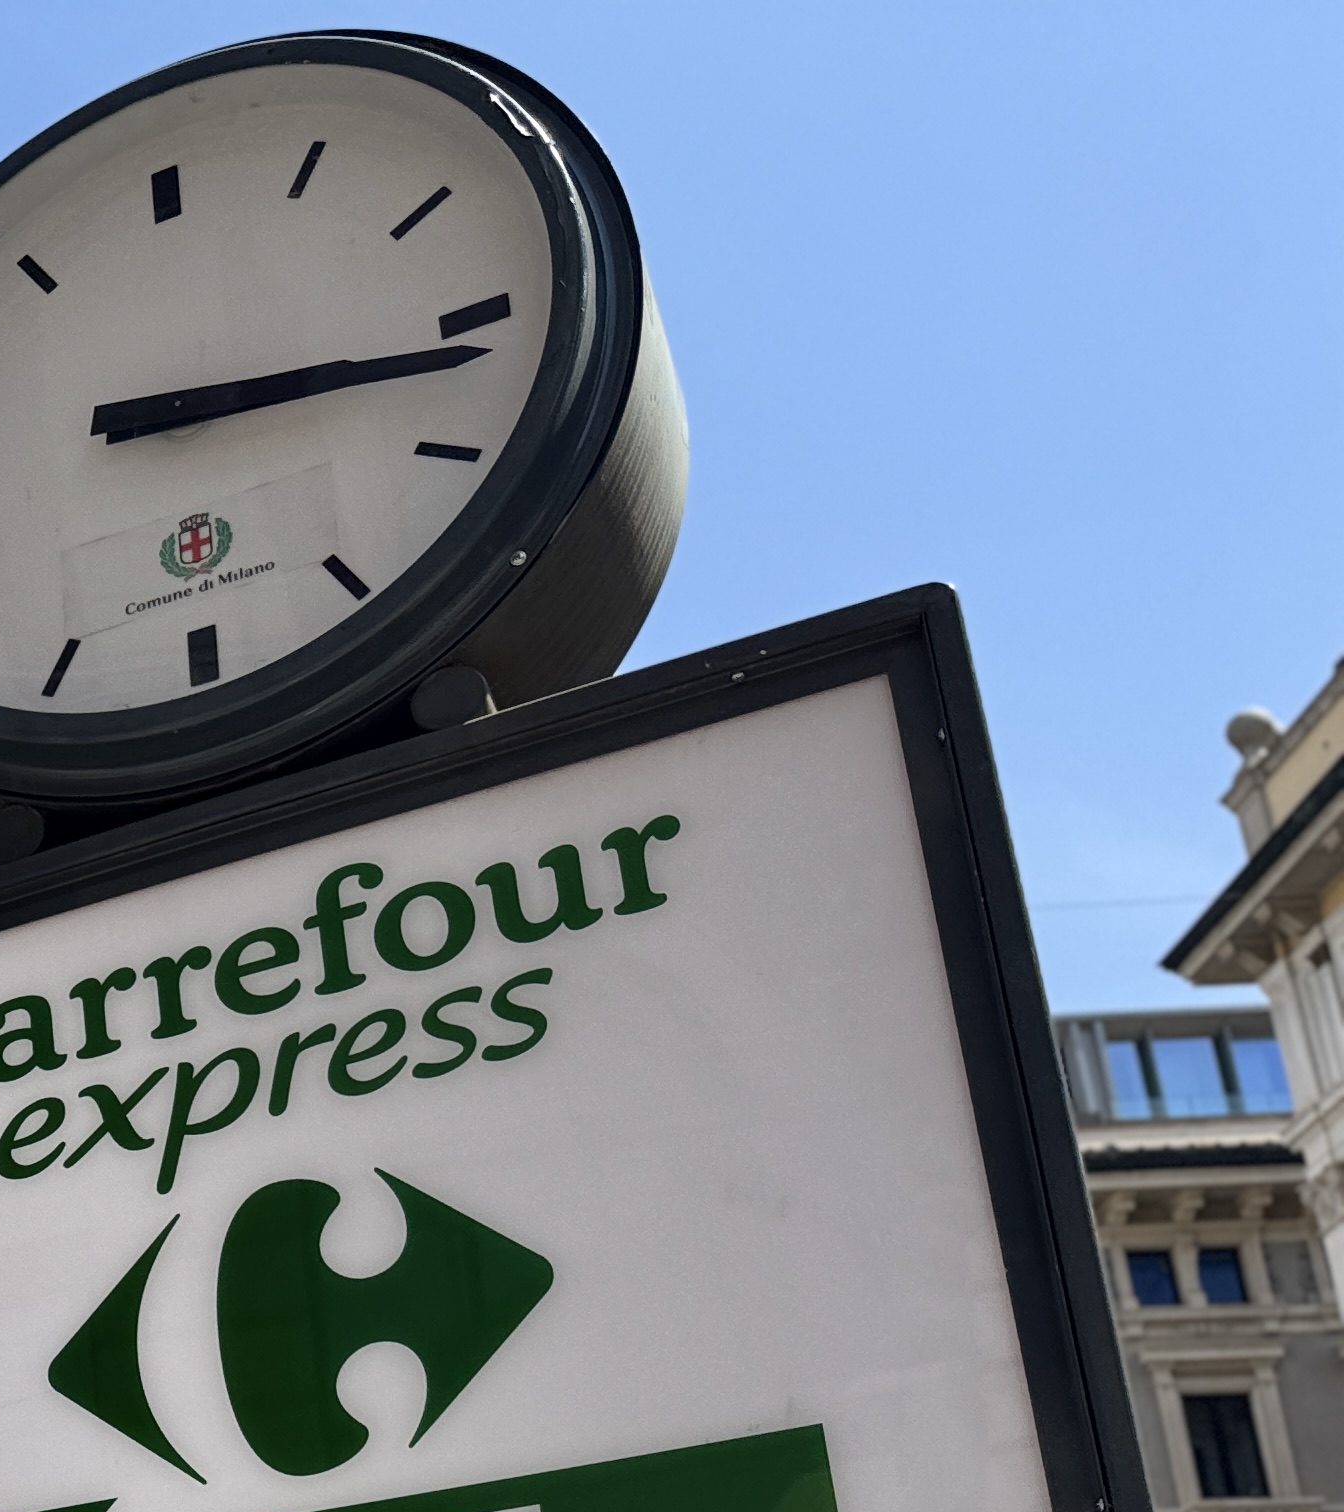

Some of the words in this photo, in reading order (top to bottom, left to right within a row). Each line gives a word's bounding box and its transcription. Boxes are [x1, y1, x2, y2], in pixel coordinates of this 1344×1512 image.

[124, 587, 193, 616] Comune
[199, 577, 214, 593] di
[217, 560, 276, 586] Milano
